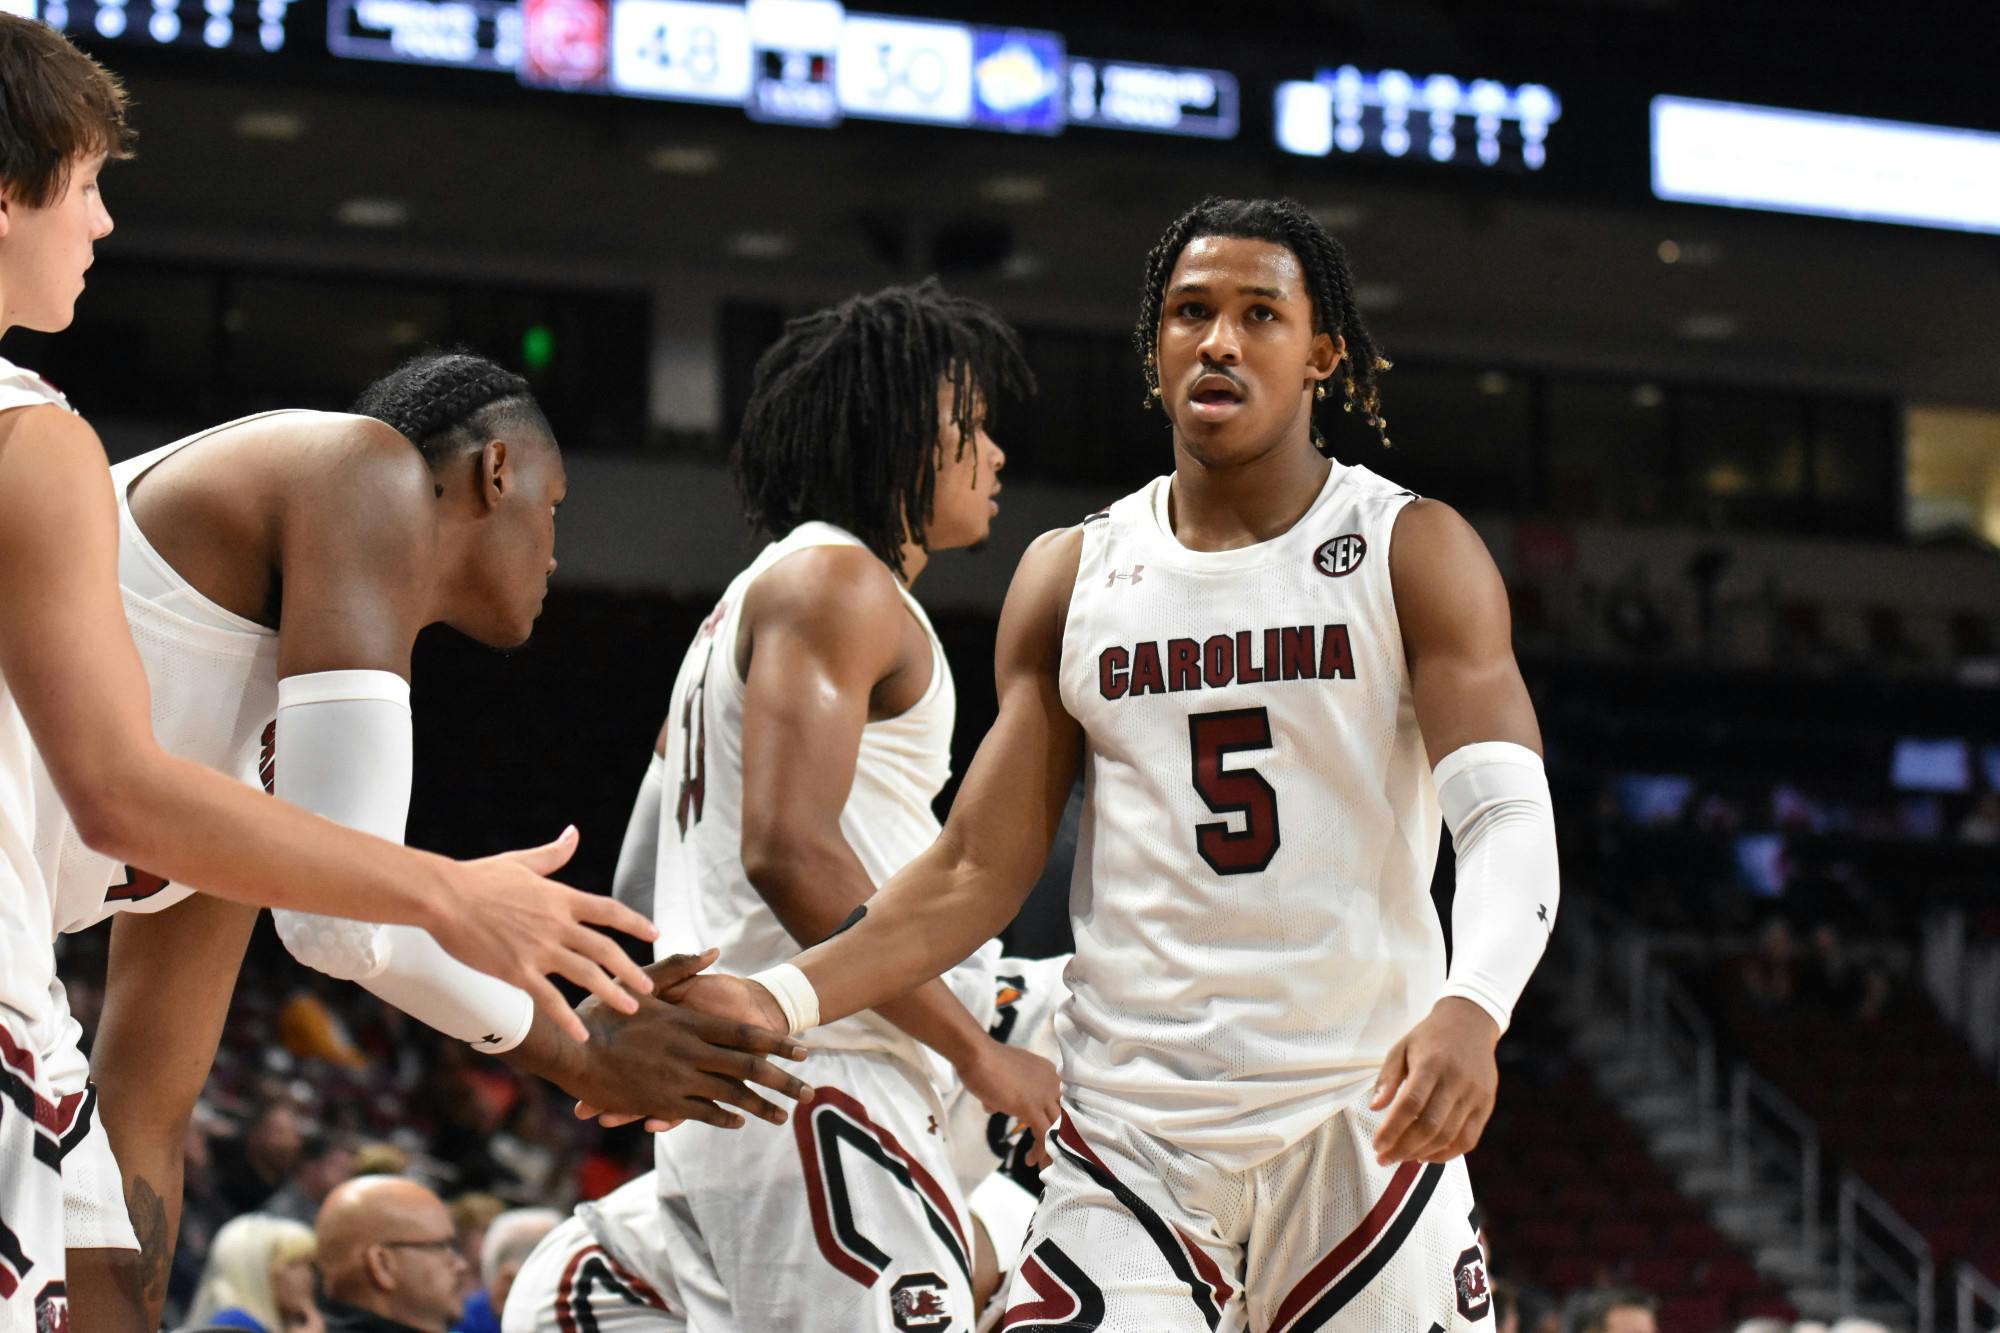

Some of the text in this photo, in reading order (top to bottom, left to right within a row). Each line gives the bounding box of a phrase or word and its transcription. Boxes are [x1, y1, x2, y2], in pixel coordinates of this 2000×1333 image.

[1319, 536, 1362, 573] SEC
[1099, 623, 1356, 701] CAROLINA
[1188, 706, 1281, 876] 5
